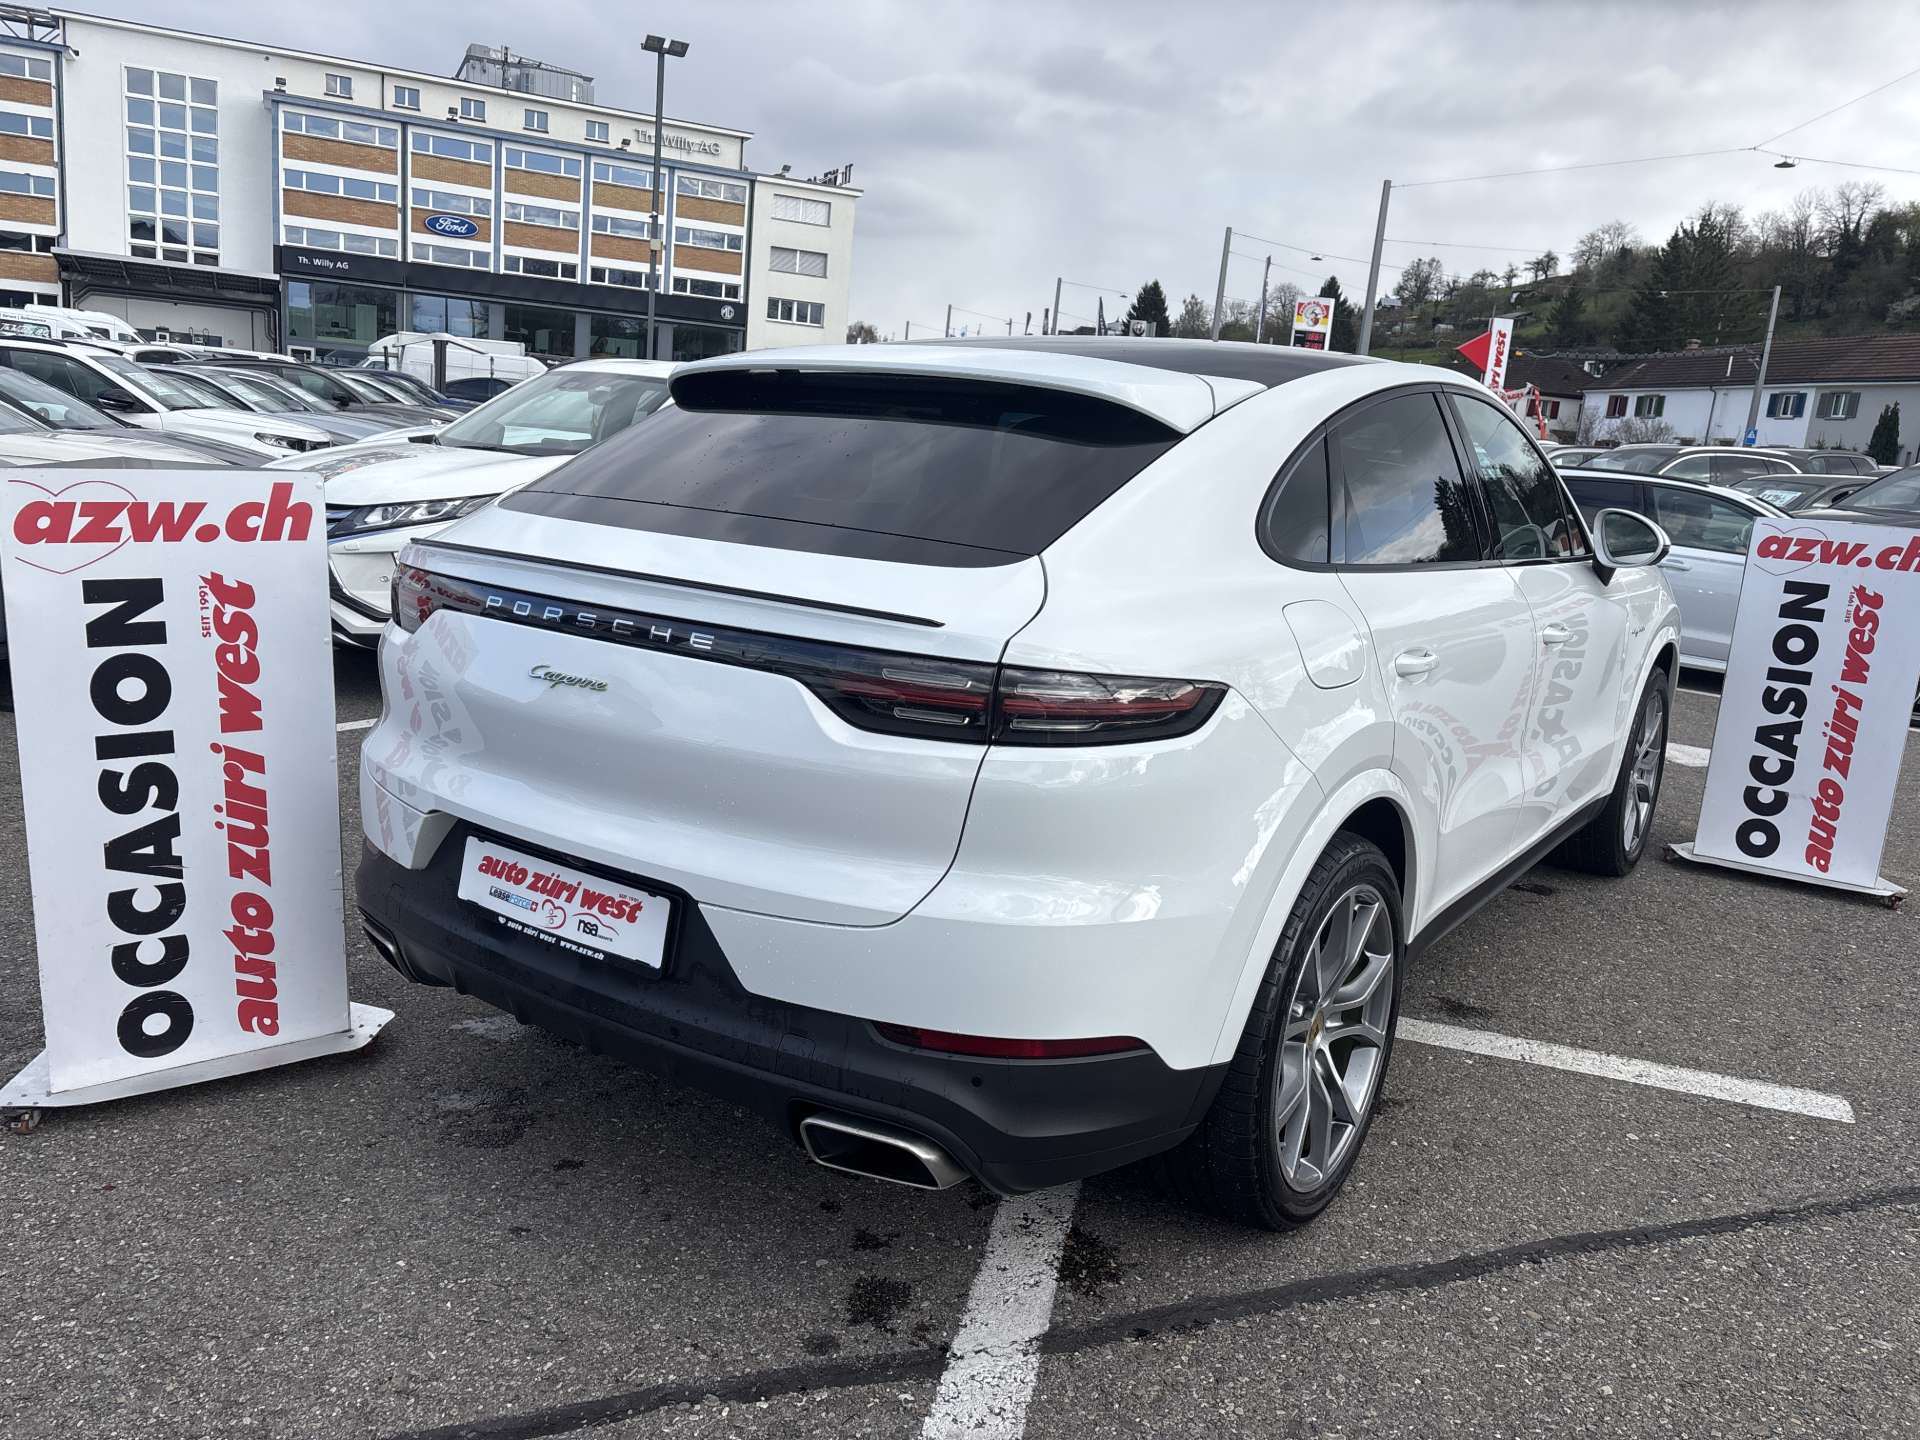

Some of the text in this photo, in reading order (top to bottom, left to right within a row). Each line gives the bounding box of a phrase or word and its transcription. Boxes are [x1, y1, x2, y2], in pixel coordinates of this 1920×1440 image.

[661, 133, 695, 153] Willy
[700, 140, 721, 155] AG
[436, 217, 469, 233] Ford
[297, 255, 349, 269] Th. Willy AG
[1494, 330, 1507, 368] west
[14, 483, 312, 544] azw.ch
[199, 585, 212, 638] SEIT 1991
[485, 595, 715, 650] PORSCHE
[528, 664, 609, 692] Cayenne
[1735, 580, 1831, 859] OCCASION
[1805, 584, 1884, 873] auto züri west
[82, 577, 194, 1058] OCCASION
[200, 572, 279, 1036] auto züri west
[478, 855, 643, 924] auto züri west
[507, 920, 522, 932] auto
[540, 931, 557, 944] west
[577, 919, 599, 938] nsa
